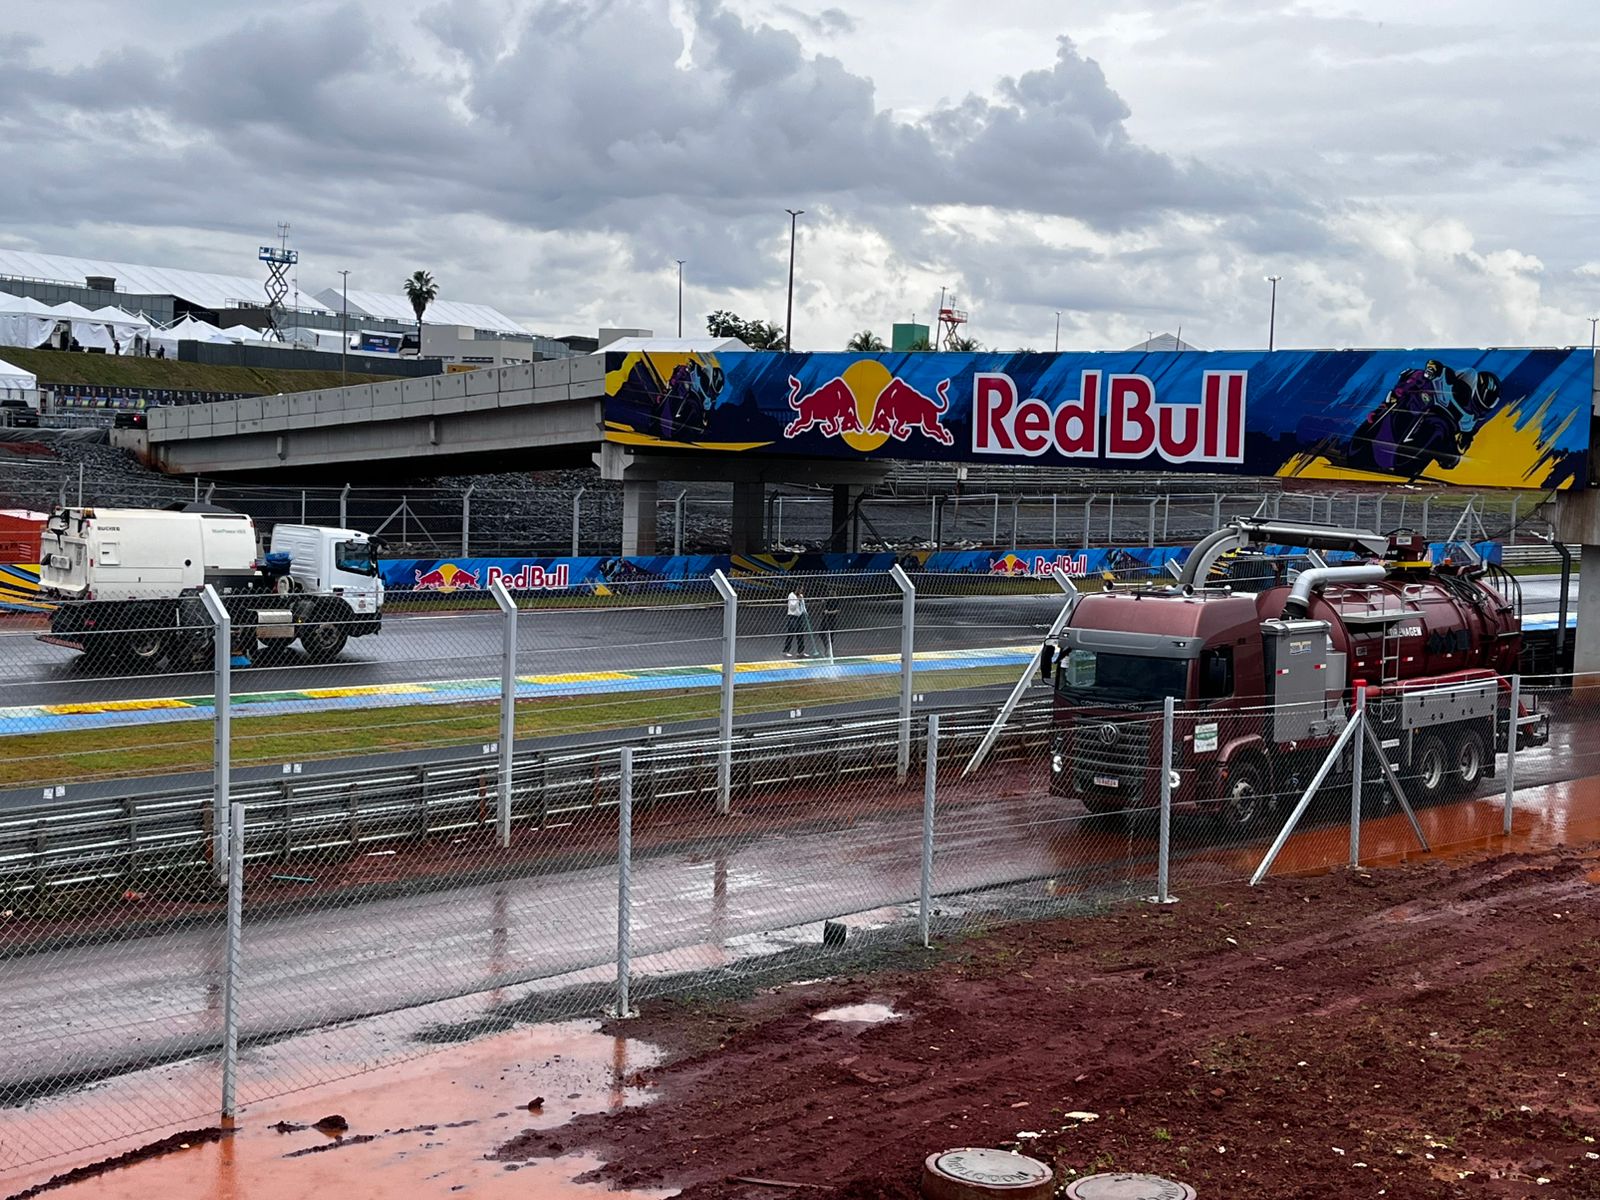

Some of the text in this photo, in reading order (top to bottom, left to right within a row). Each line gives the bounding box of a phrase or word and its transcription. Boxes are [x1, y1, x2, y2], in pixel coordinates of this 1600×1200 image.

[973, 370, 1247, 464] Red Bull
[530, 564, 569, 589] Bull
